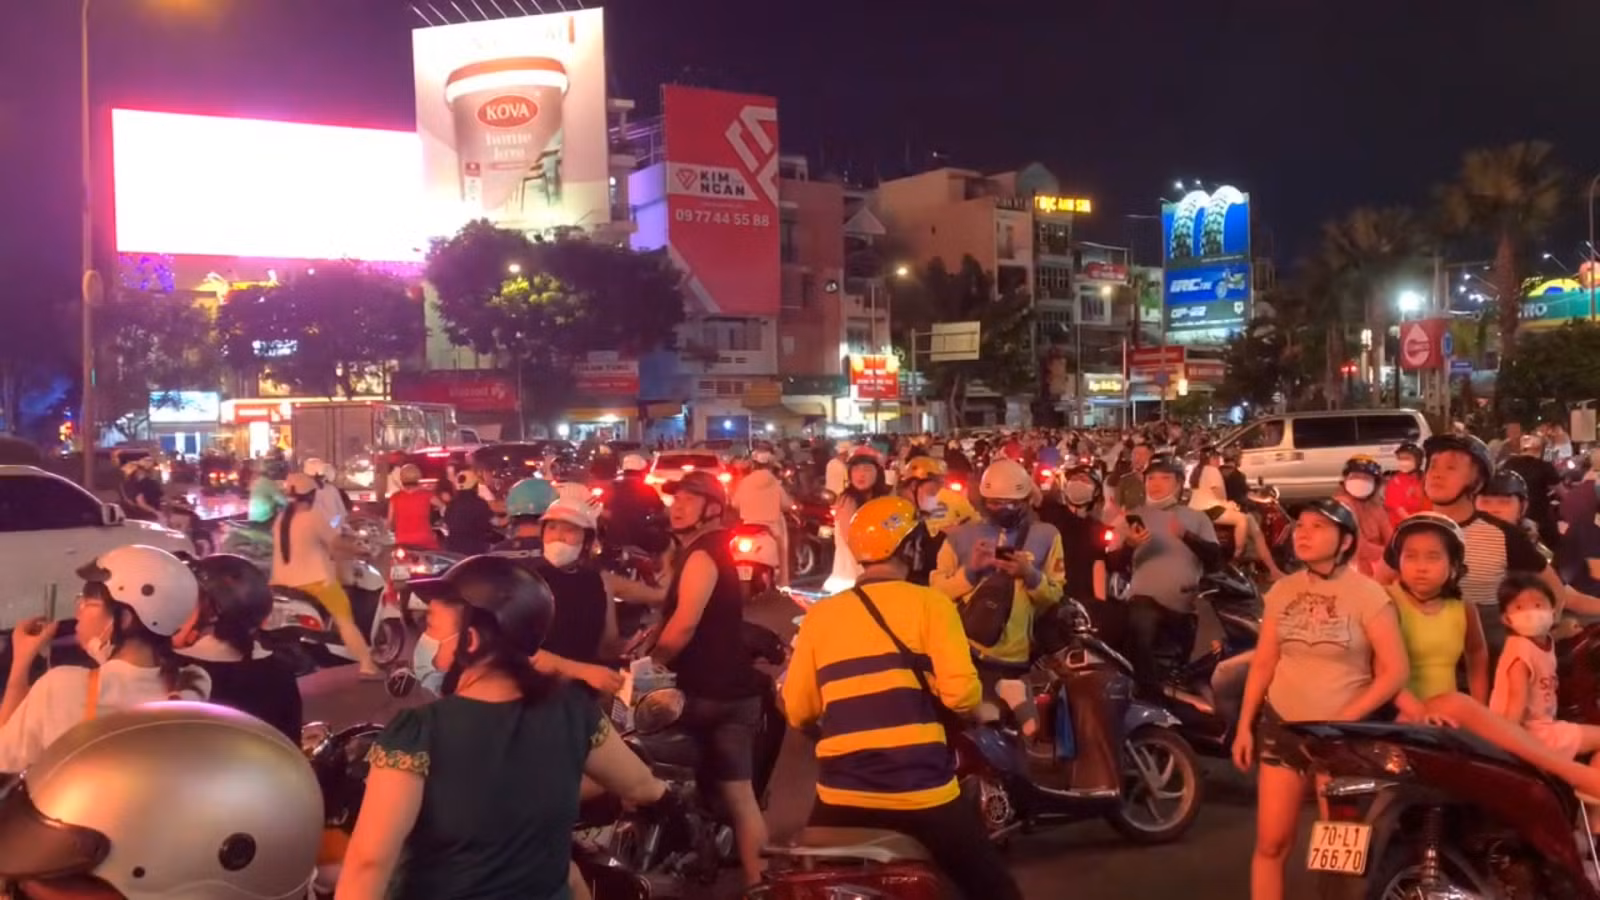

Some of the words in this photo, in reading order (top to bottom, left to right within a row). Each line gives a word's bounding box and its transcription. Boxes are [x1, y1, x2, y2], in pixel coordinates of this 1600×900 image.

[486, 102, 529, 120] KOVA
[701, 171, 729, 182] KIM
[1310, 847, 1362, 871] 766.70
